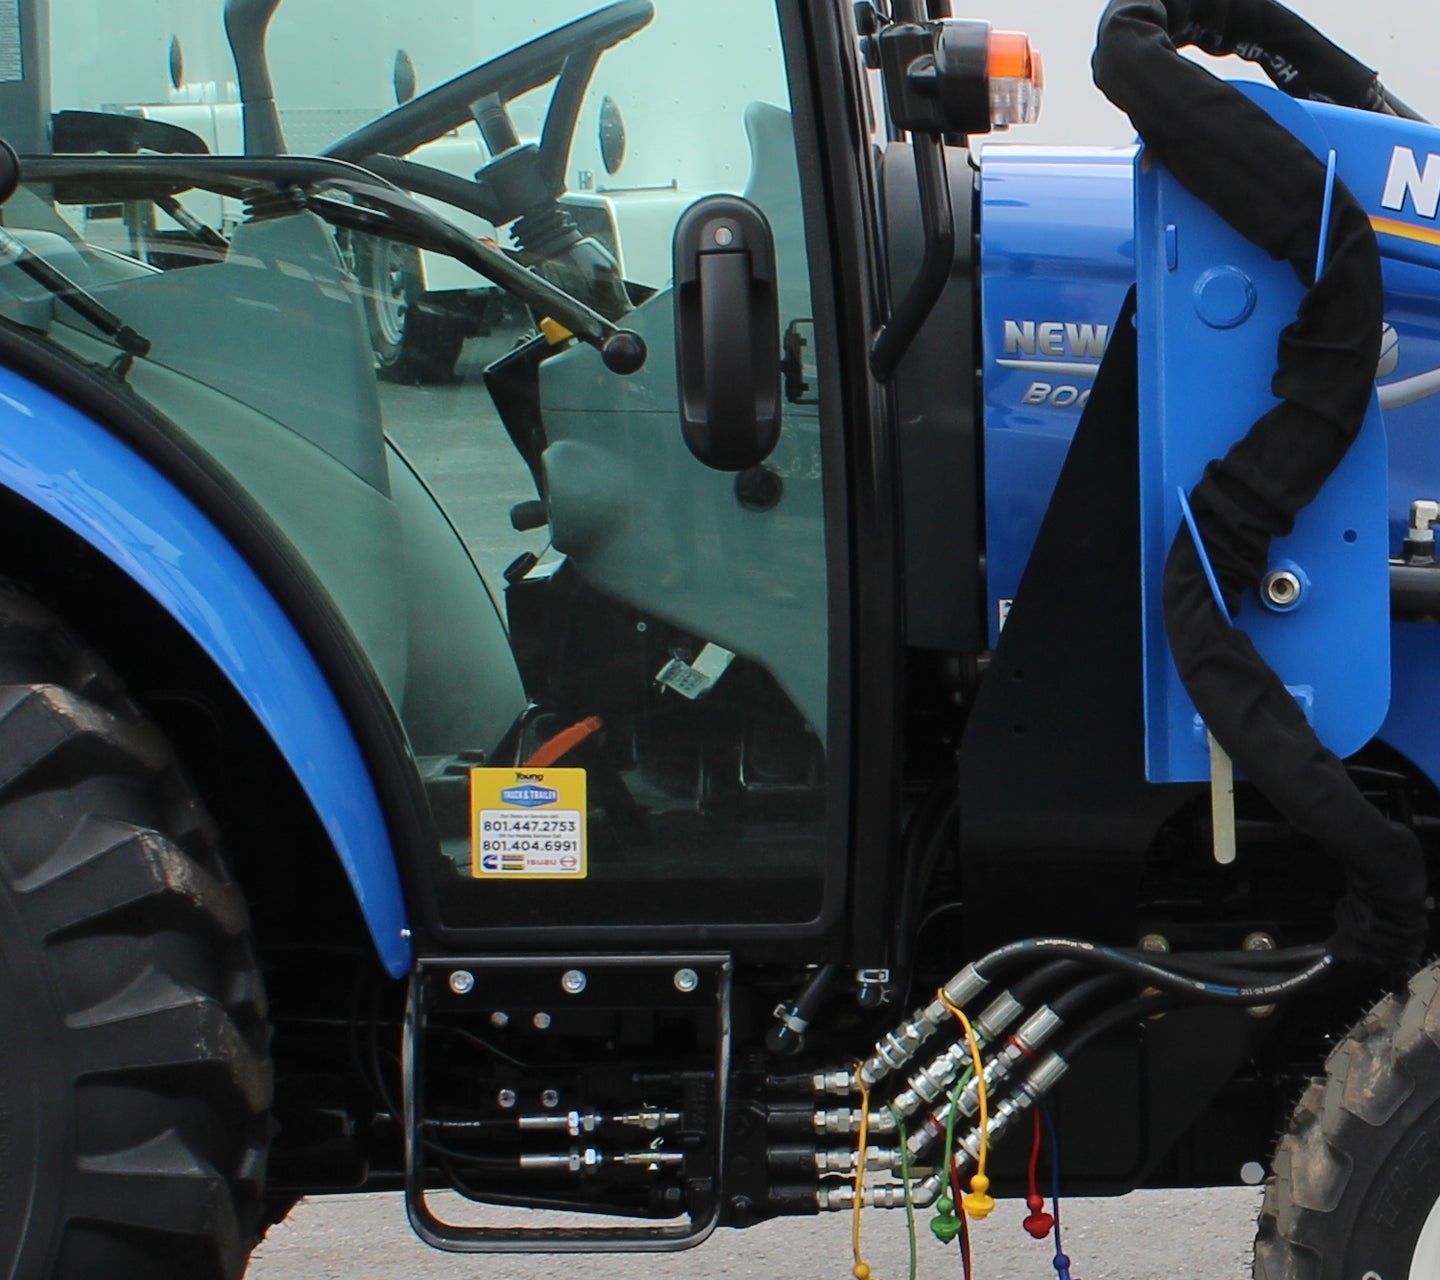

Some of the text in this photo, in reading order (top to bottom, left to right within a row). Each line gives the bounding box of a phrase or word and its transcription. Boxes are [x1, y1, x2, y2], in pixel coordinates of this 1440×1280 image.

[1004, 320, 1109, 358] NEW
[515, 772, 544, 782] Young
[484, 821, 576, 832] 801.447.2753
[483, 841, 577, 851] 801.404.6991
